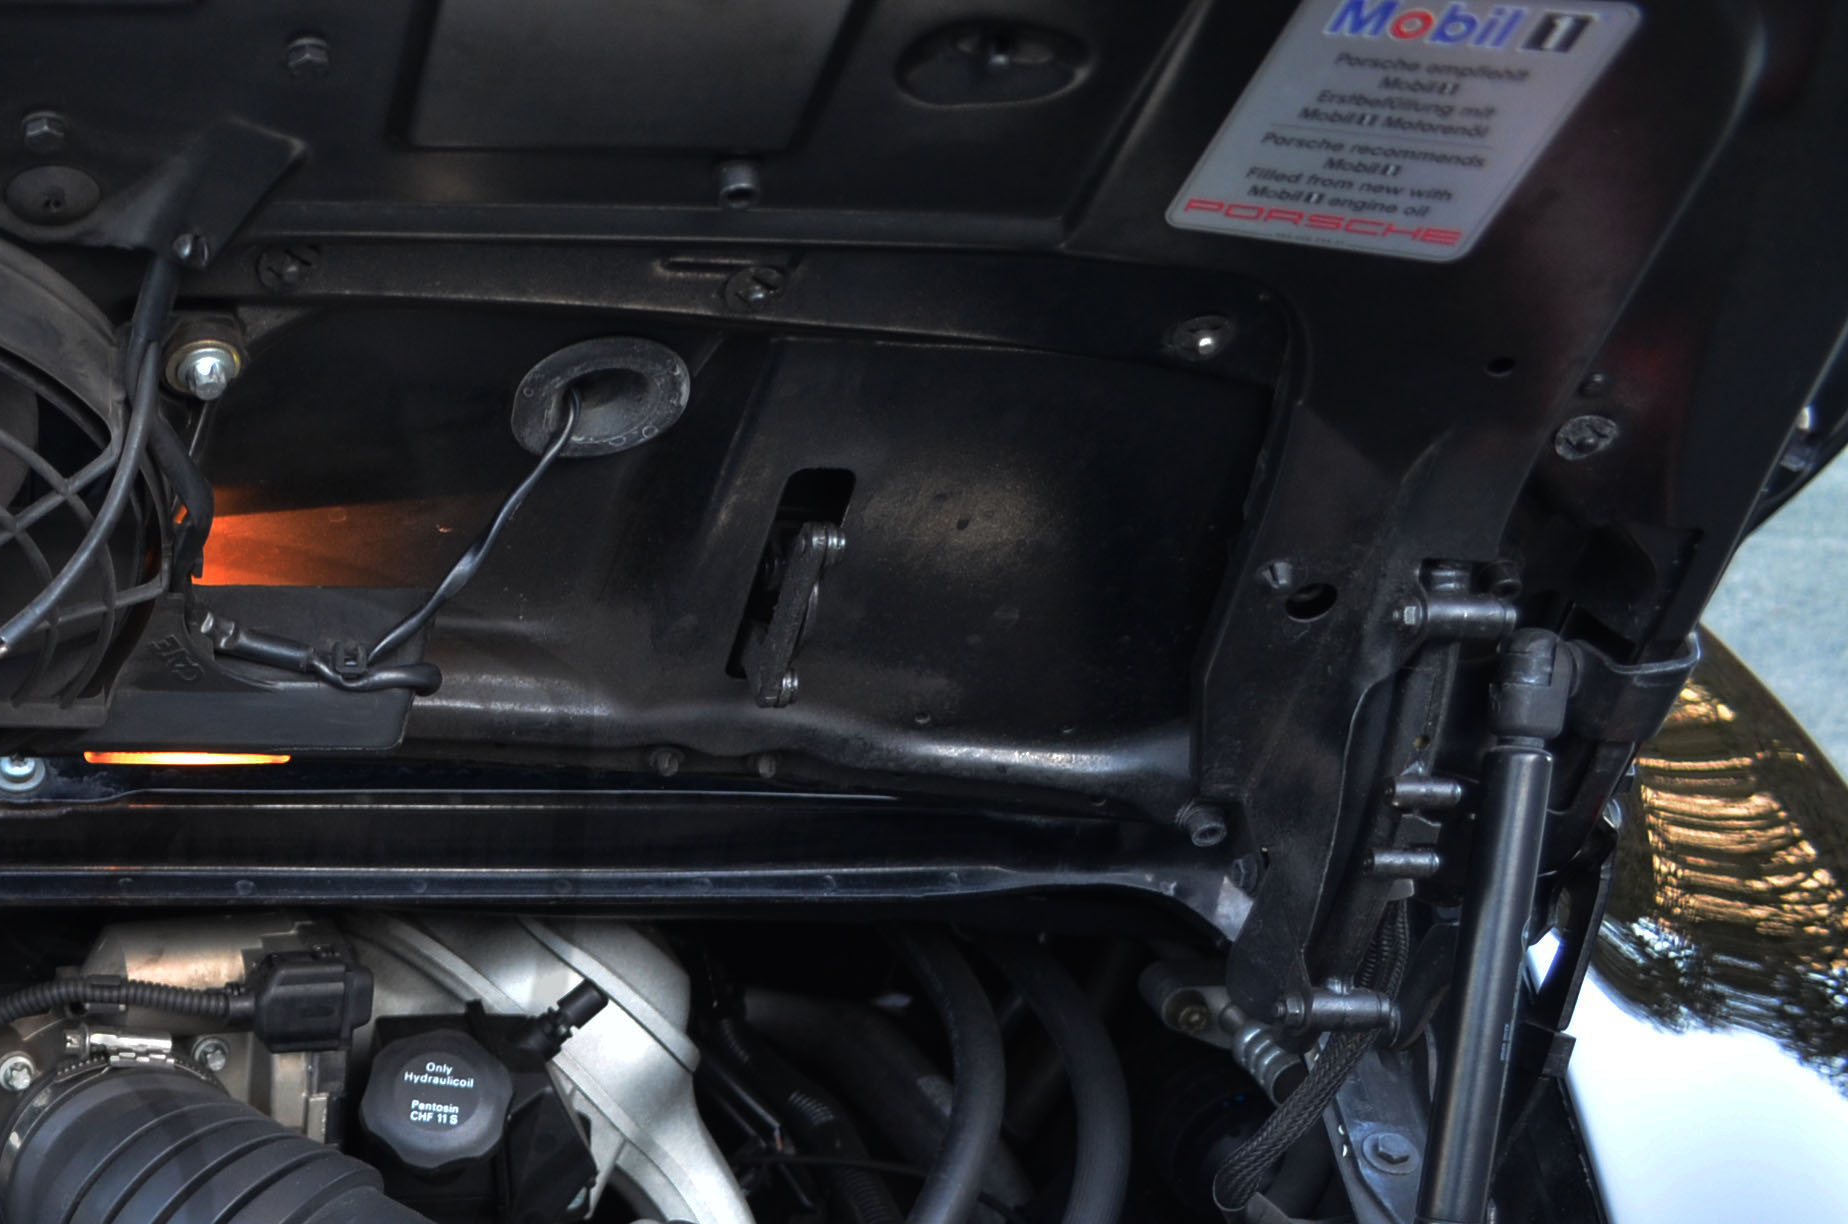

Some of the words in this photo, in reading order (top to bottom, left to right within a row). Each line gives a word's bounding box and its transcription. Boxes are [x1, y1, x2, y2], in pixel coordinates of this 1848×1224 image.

[1326, 0, 1523, 48] Mobil
[1336, 53, 1420, 71] Porsche
[1459, 105, 1496, 119] mit
[1382, 116, 1489, 138] Motorenöl
[1261, 131, 1345, 152] Porsche
[1351, 143, 1486, 168] recommends
[1246, 166, 1302, 184] Filled
[1306, 173, 1353, 190] from
[1360, 182, 1403, 196] new
[1409, 187, 1454, 202] with
[1328, 195, 1398, 218] engine
[1403, 204, 1430, 219] oil
[1184, 197, 1463, 246] PORSCHE
[426, 1062, 453, 1075] Only
[404, 1071, 474, 1088] Hydraulicoil
[411, 1099, 459, 1113] Pentosin
[409, 1111, 433, 1123] CHF
[437, 1113, 447, 1125] 11
